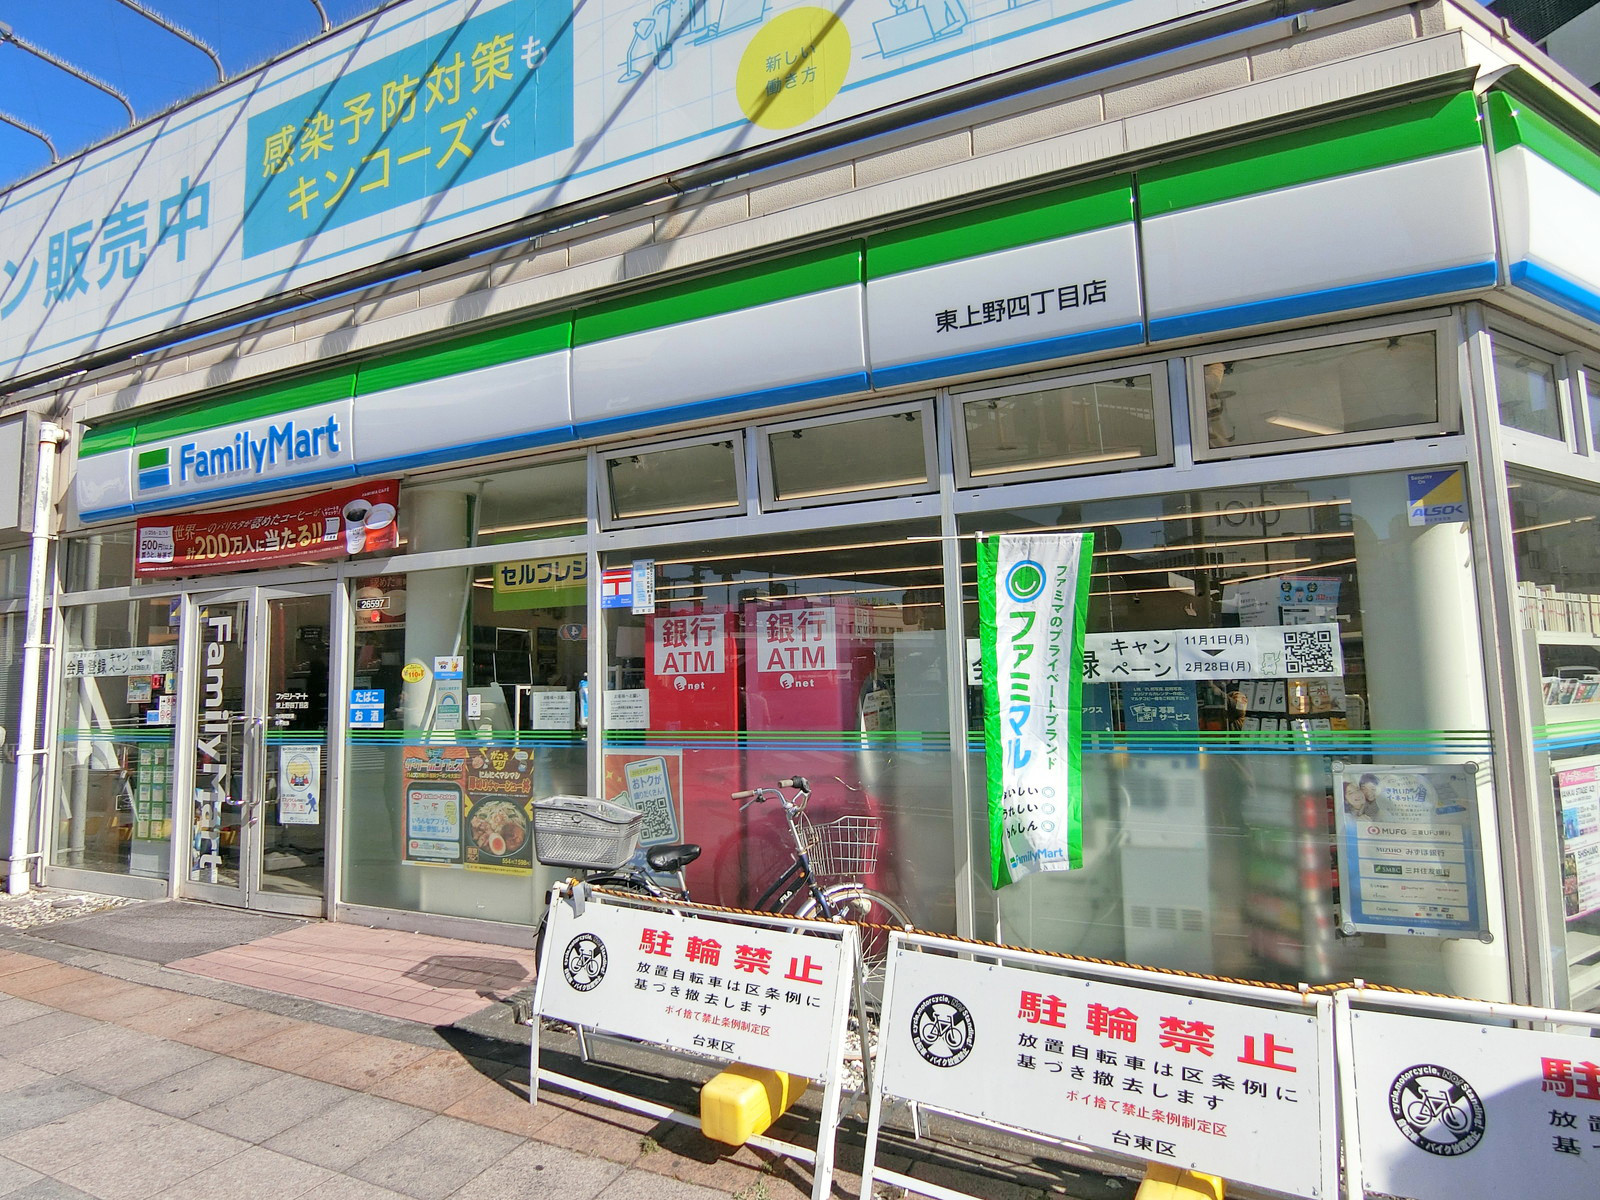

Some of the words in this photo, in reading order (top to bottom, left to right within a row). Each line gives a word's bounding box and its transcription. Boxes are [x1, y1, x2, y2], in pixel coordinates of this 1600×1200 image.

[765, 45, 816, 73] 新しい
[765, 66, 817, 97] 働き方
[262, 33, 548, 178] 感染予防対策も
[287, 107, 511, 220] キンコーズで
[0, 175, 209, 318] ン販売中
[935, 279, 1107, 333] 東上野四丁目店
[180, 414, 341, 481] FamilyMart
[1411, 504, 1463, 518] ALSOK
[501, 557, 588, 586] セルフレジ
[361, 599, 385, 609] 26597
[662, 617, 716, 648] 銀行
[766, 611, 827, 643] 銀行
[1183, 634, 1250, 646] 11月1日(月)
[662, 650, 715, 673] ATM
[766, 646, 826, 670] ATM
[1110, 638, 1170, 655] キャン
[1045, 565, 1068, 770] ファミマのプライベートブランド
[1111, 662, 1172, 678] ペーン
[1185, 660, 1252, 673] 2月28日(月)
[355, 691, 379, 702] たばこ
[1006, 611, 1037, 769] ファミマル
[1159, 713, 1191, 721] サービス
[1405, 849, 1445, 857] みずほ銀行
[779, 890, 793, 904] FILA
[638, 928, 823, 985] 駐輪禁止
[633, 978, 772, 1016] 基づき撤去します
[636, 961, 821, 1009] 放置自転車は区条例に
[664, 1004, 771, 1037] ポイ捨て禁止条例制定区
[1017, 990, 1297, 1073] 駐輪禁止
[692, 1033, 736, 1054] 台東区
[1017, 1032, 1299, 1103] 放置自転車は区条例に
[1017, 1053, 1224, 1111] 基づき撤去します
[1065, 1089, 1228, 1138] ポイ捨て禁止条例制定区
[1111, 1129, 1177, 1158] 台東区
